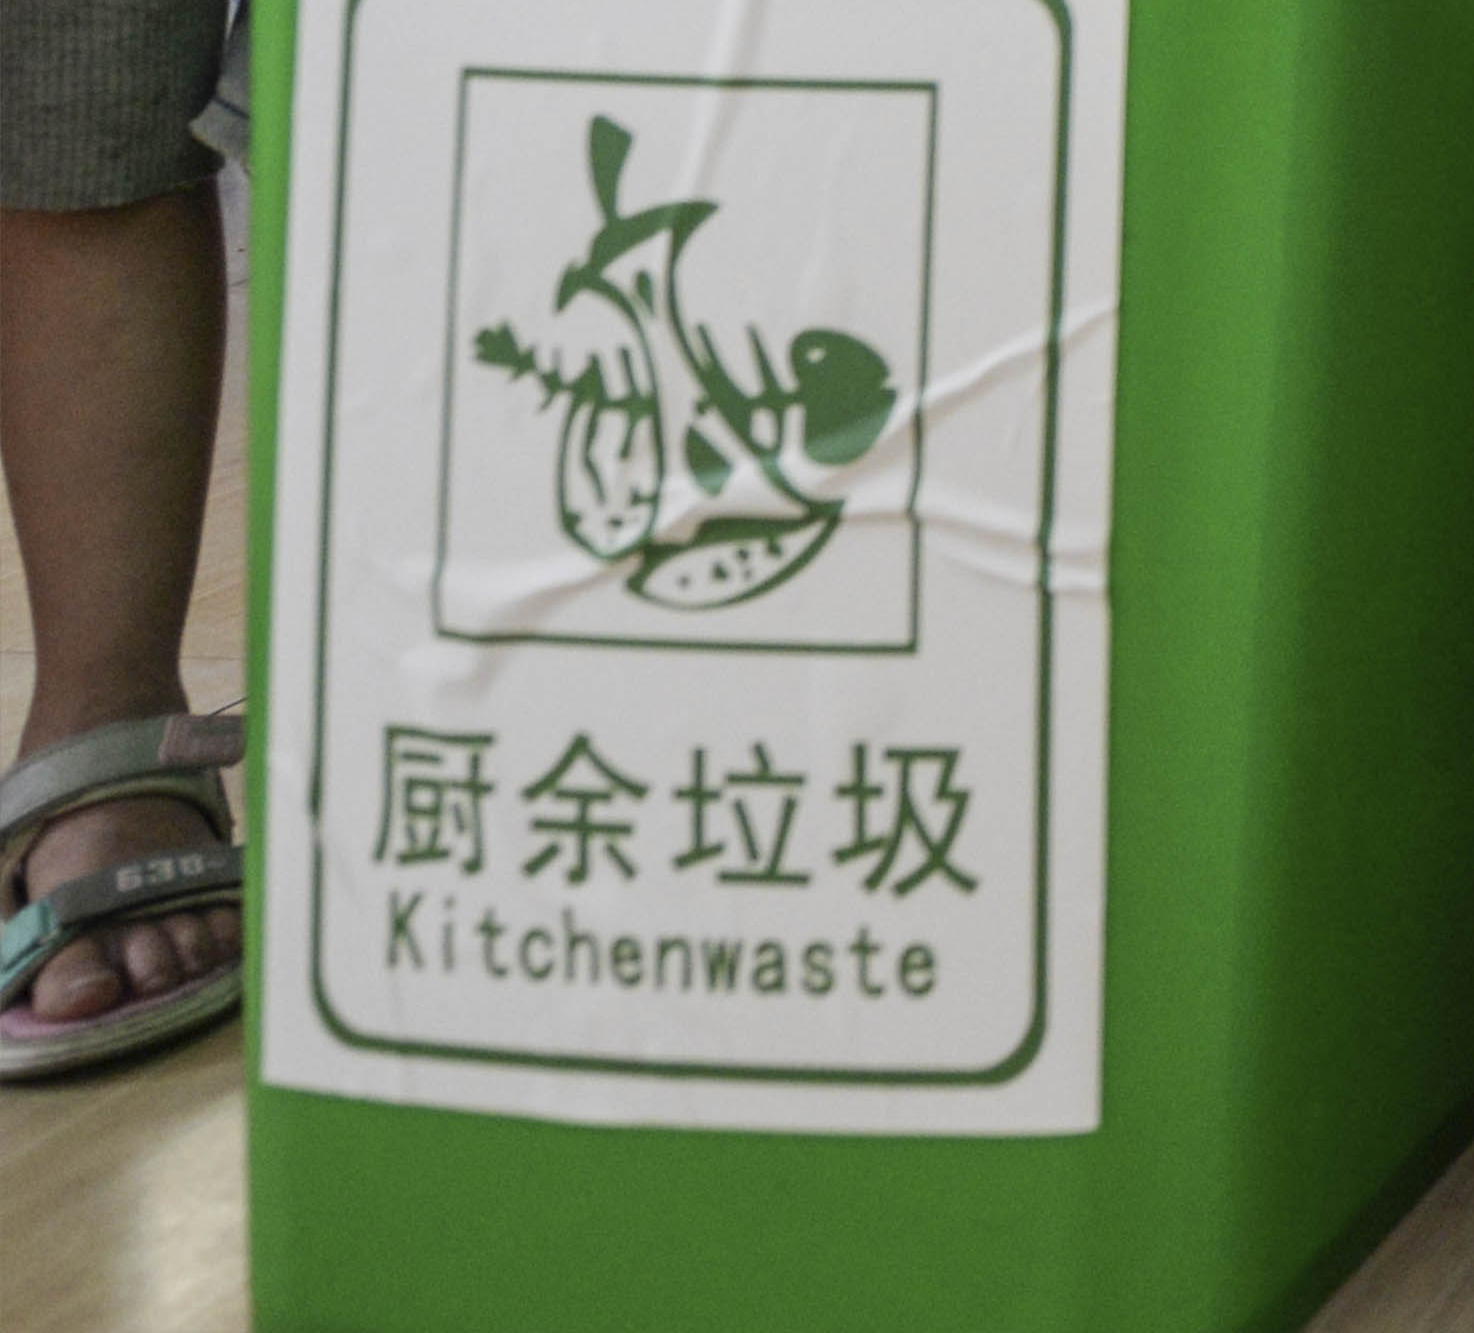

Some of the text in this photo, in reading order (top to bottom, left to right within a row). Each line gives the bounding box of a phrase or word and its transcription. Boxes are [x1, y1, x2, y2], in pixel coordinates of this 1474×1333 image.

[372, 724, 980, 897] 厨余垃圾
[386, 889, 938, 999] Kitchenwaste
